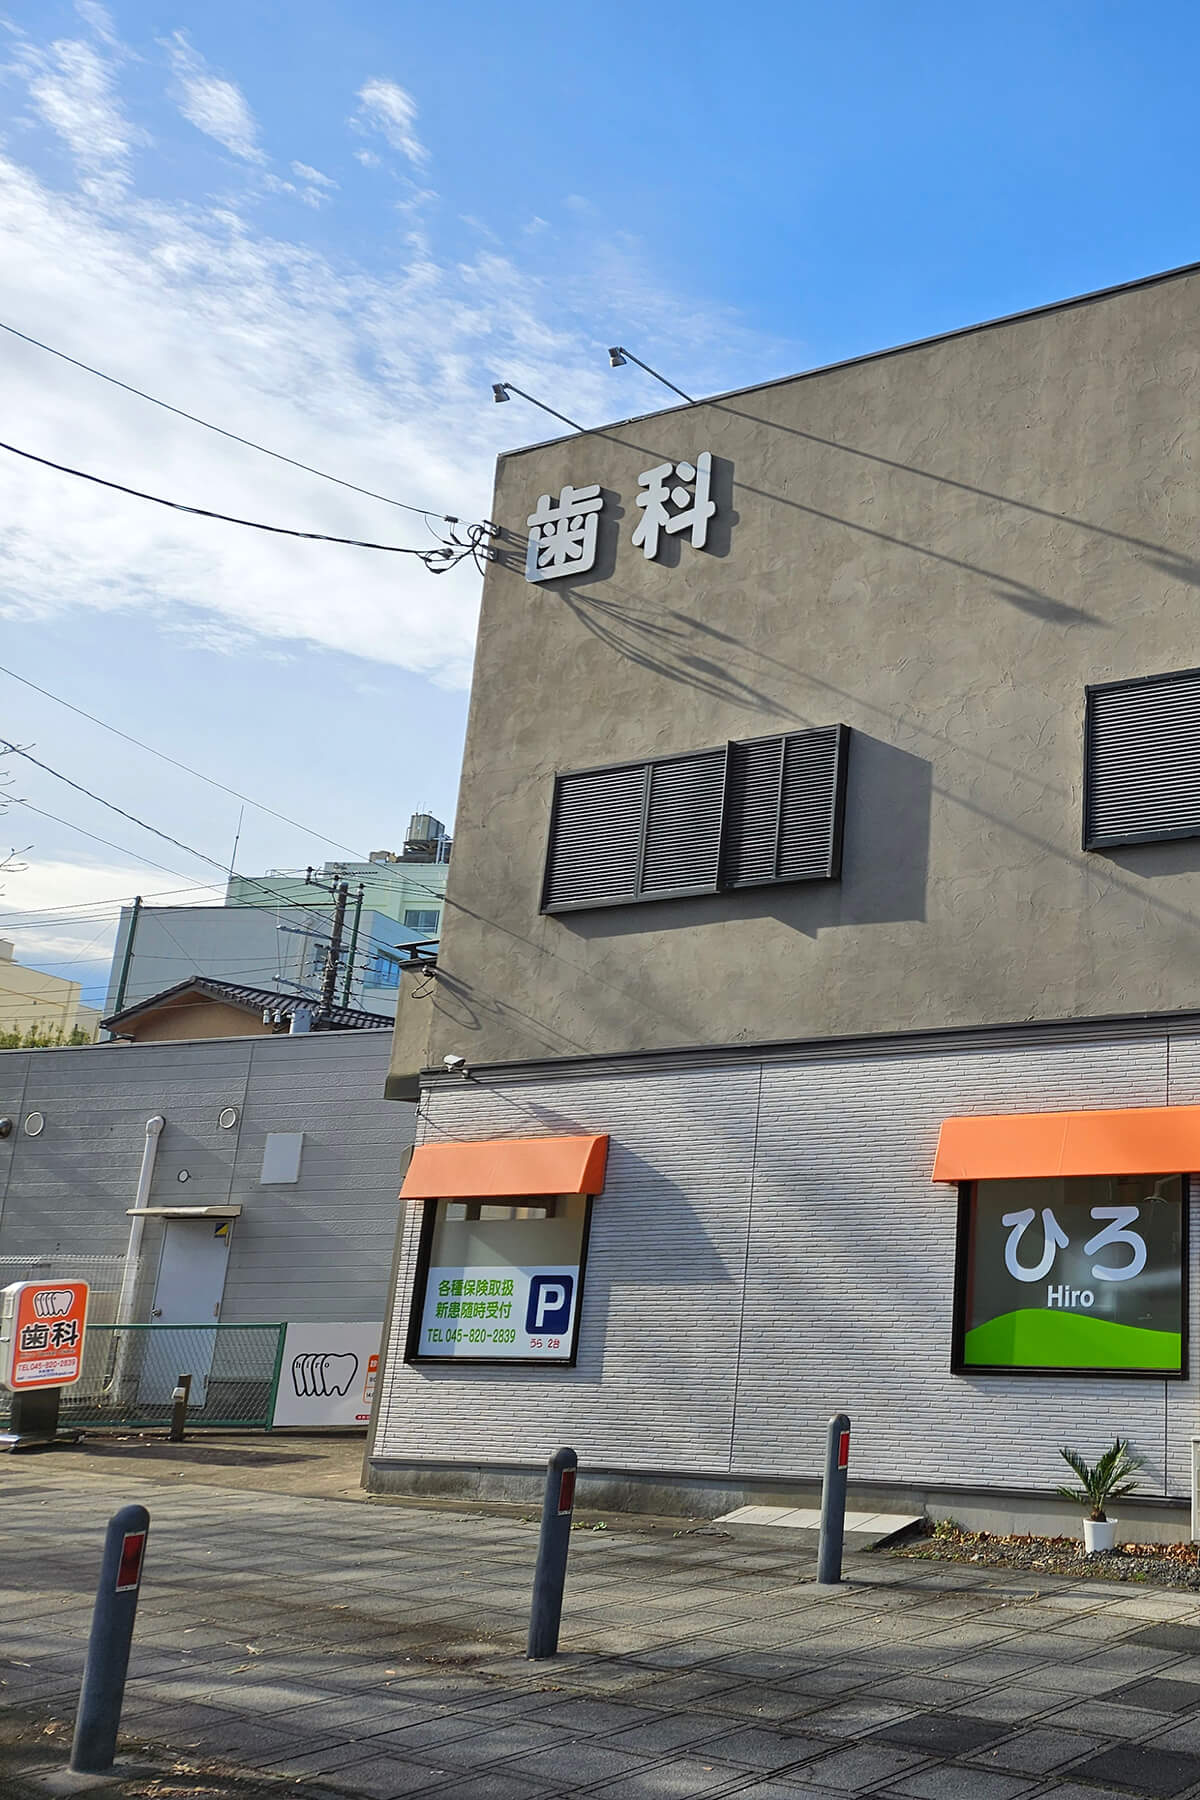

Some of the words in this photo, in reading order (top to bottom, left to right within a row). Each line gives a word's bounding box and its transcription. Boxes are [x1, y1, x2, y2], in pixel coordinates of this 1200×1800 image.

[525, 451, 716, 583] 歯科
[1001, 1205, 1147, 1283] ひろ
[438, 1279, 514, 1297] 各種保険取扱
[1046, 1285, 1095, 1308] Hiro
[436, 1301, 513, 1319] 新患随時受付
[20, 1320, 80, 1350] 歯科
[427, 1328, 443, 1343] TEL
[445, 1328, 516, 1343] 045-820-2839
